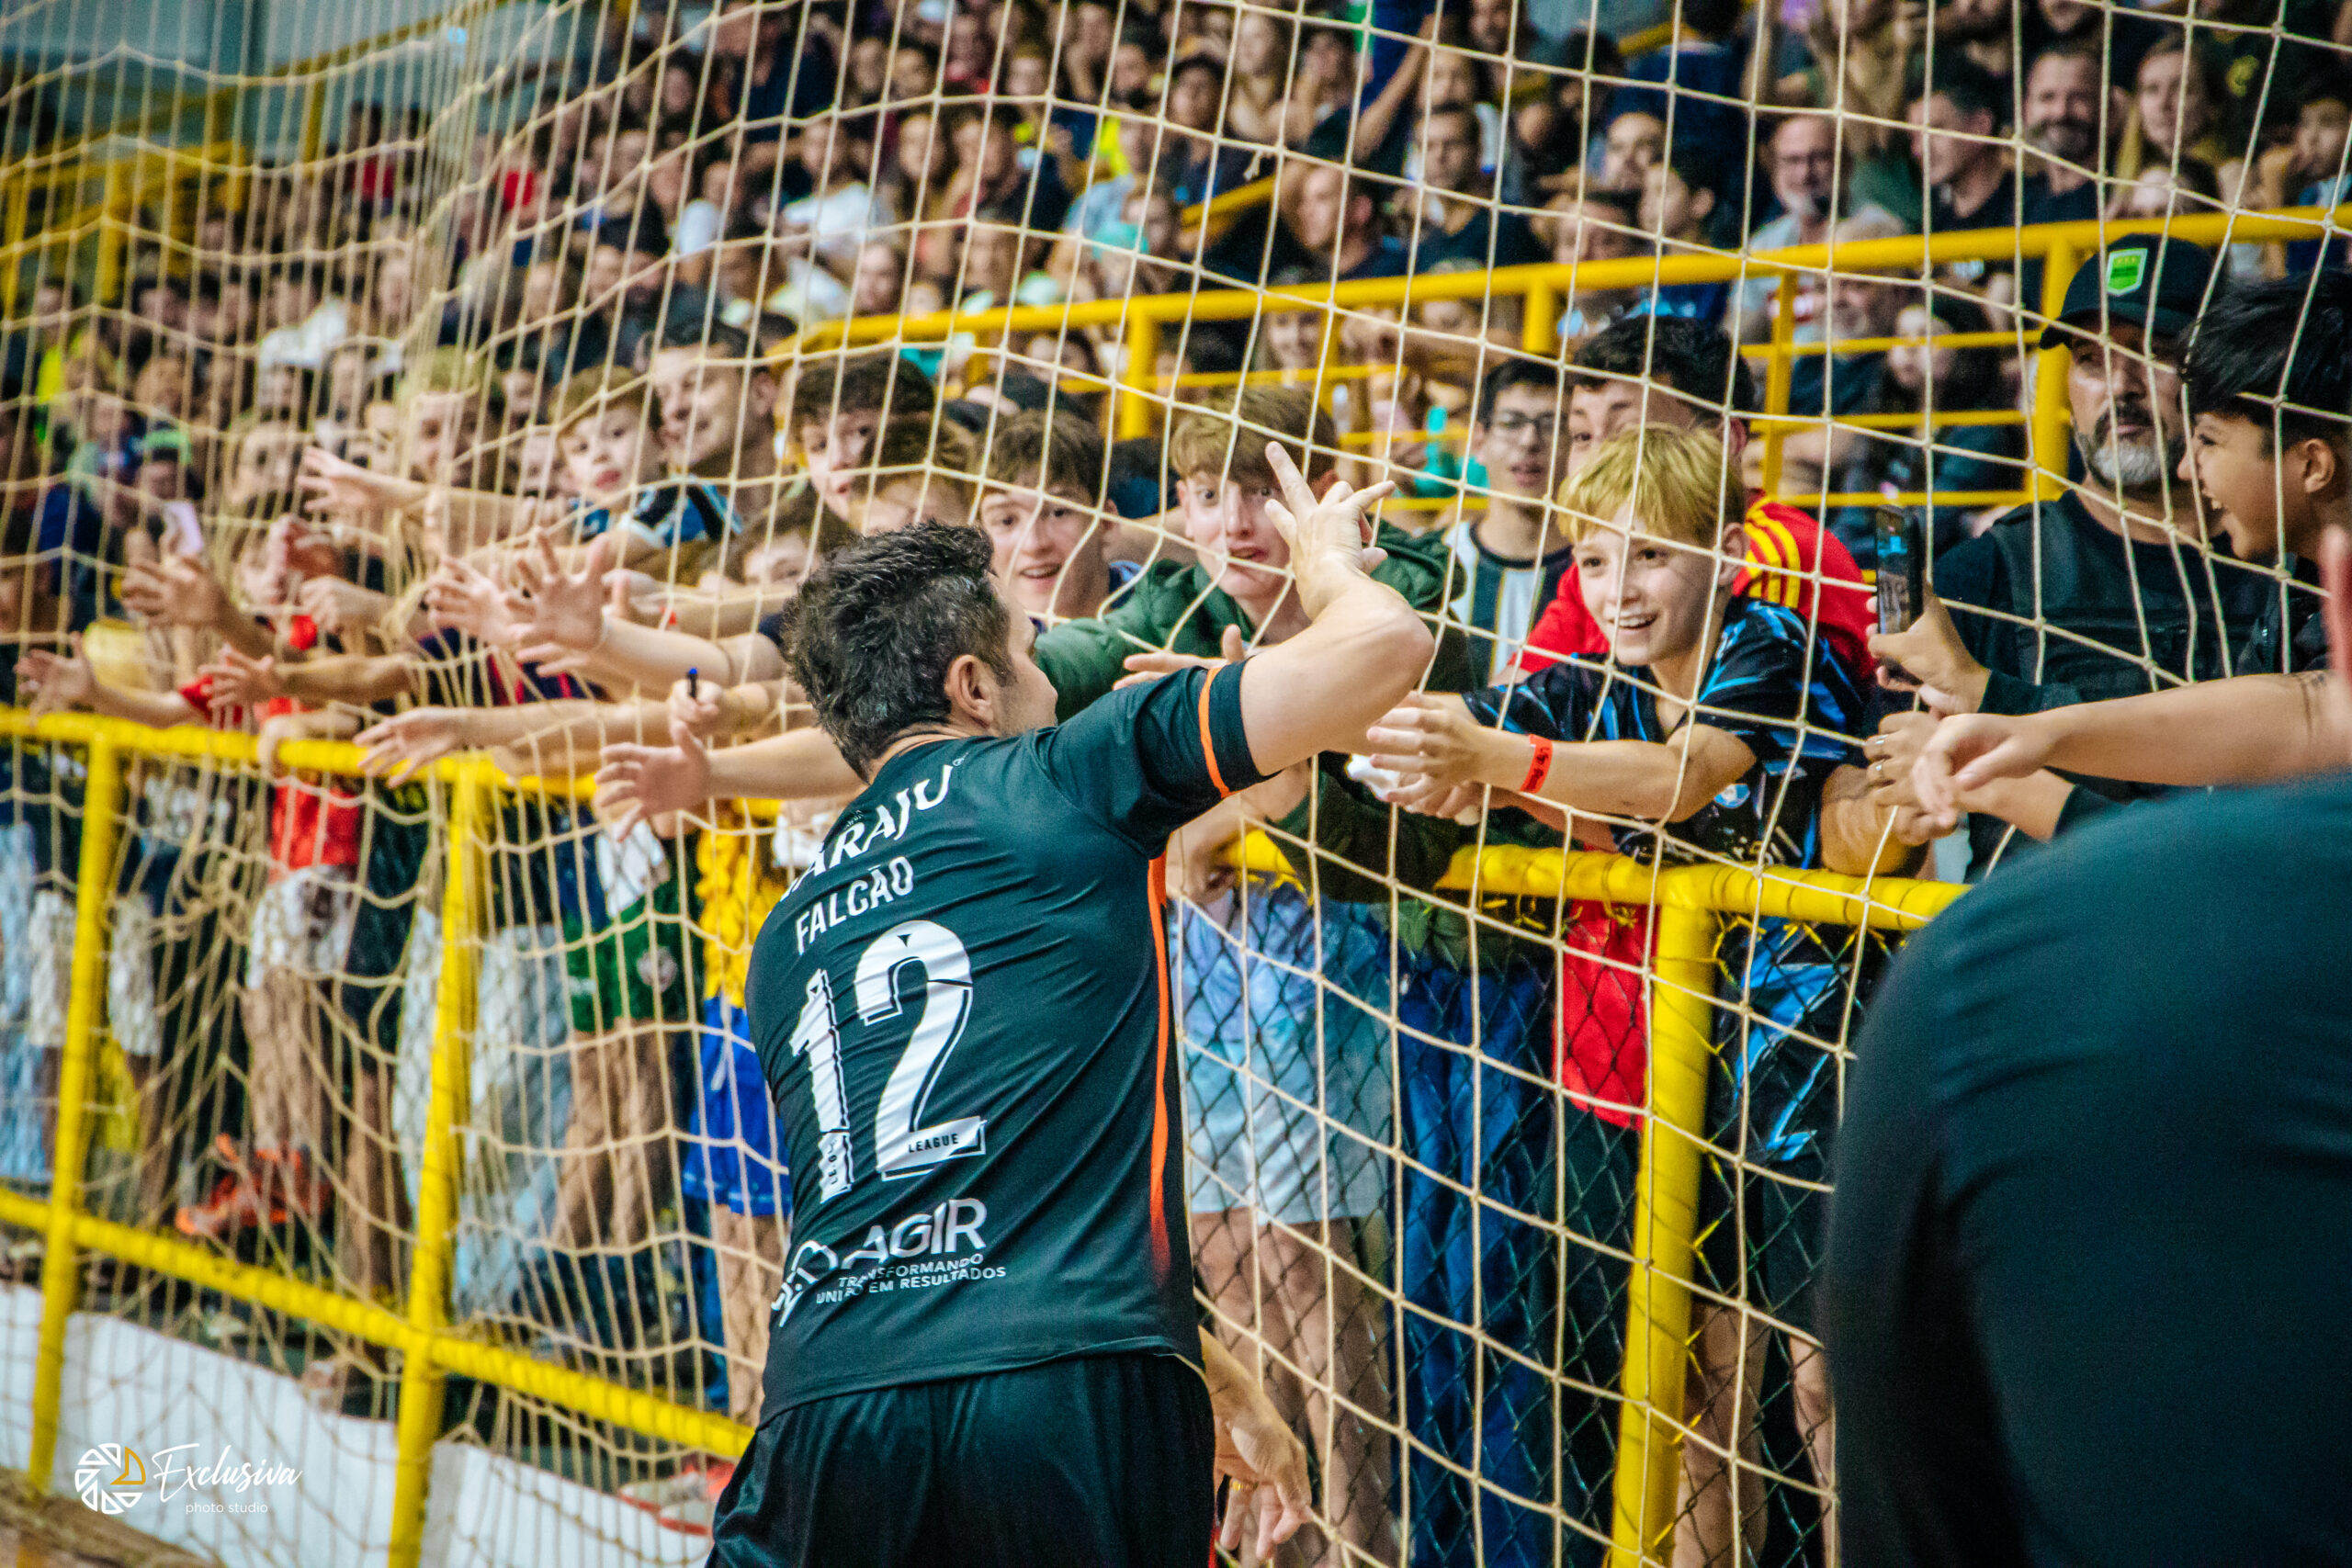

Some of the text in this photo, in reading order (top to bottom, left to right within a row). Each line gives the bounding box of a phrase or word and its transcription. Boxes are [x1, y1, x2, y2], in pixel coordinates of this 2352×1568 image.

[778, 763, 954, 903] ARAJU
[795, 856, 914, 956] FALCÃO
[788, 919, 988, 1204] 12
[908, 1133, 959, 1153] LEAGUE
[841, 1198, 987, 1269] AGIR
[838, 1253, 984, 1288] TRANSFORMANDO
[869, 1280, 894, 1294] EM
[899, 1267, 1007, 1289] RESULTADOS
